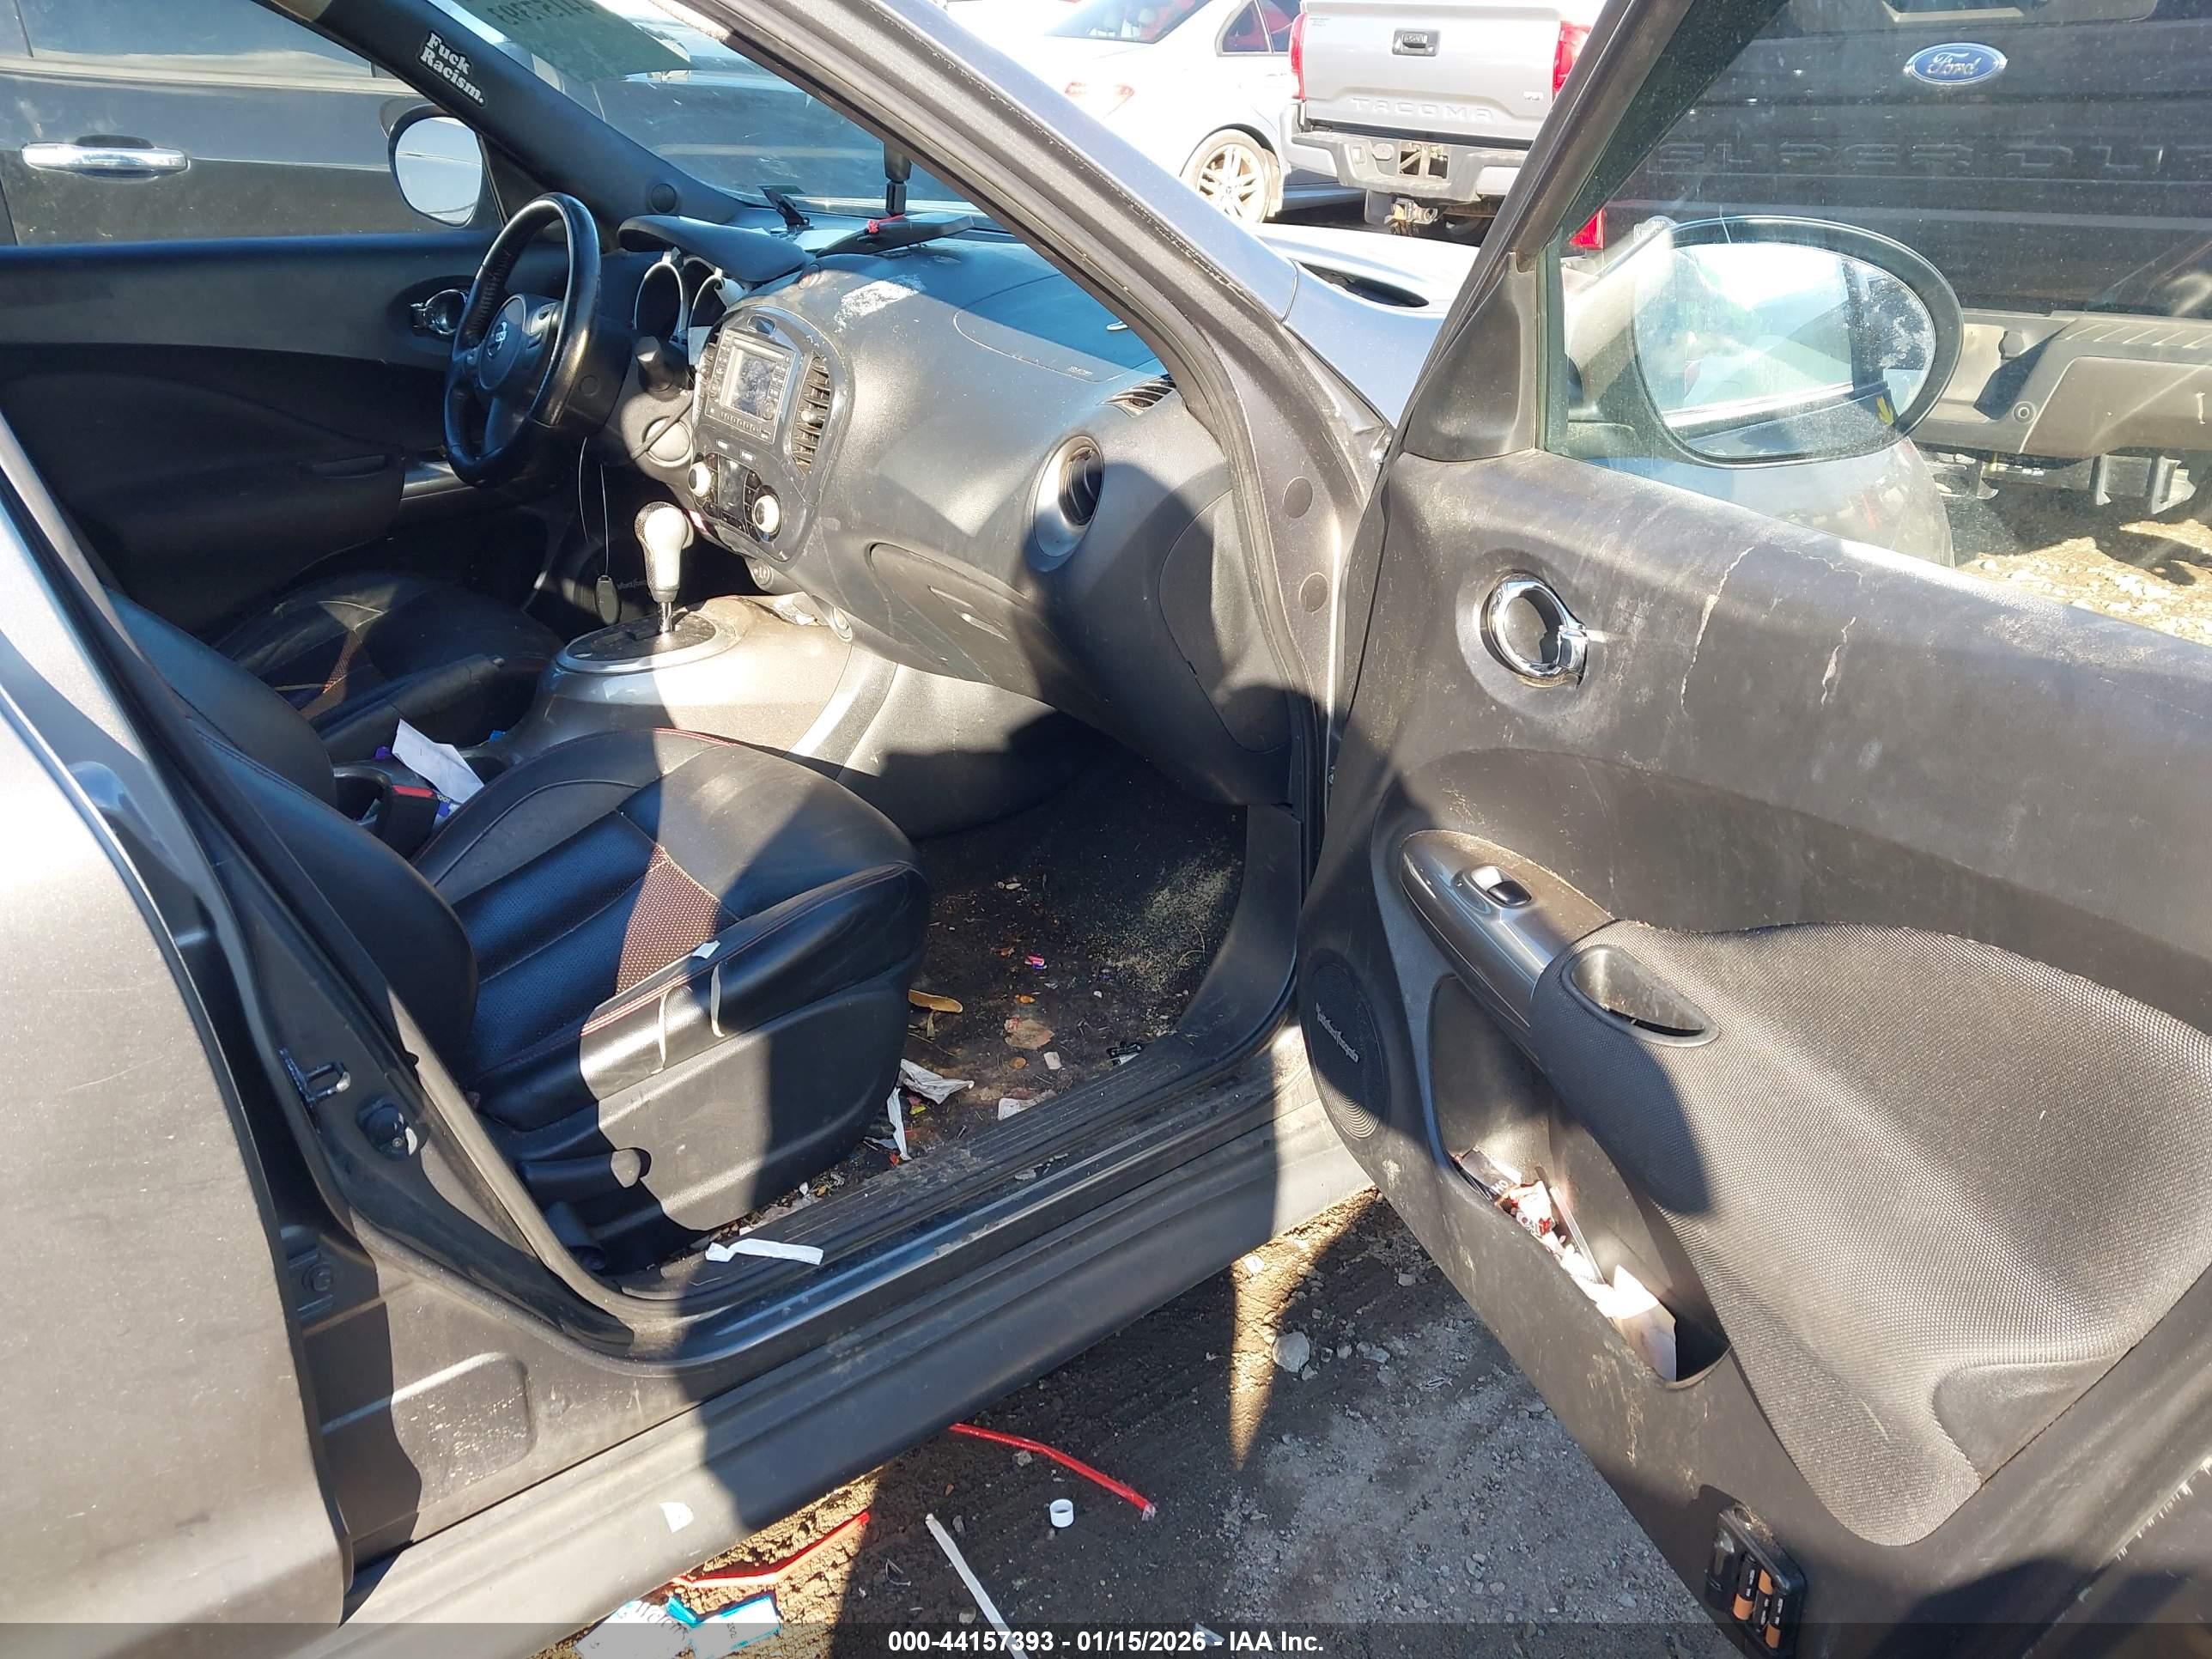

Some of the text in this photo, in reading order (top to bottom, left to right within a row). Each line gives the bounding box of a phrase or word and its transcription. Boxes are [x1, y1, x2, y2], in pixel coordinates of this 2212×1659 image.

[426, 33, 471, 76] Fuck
[1926, 52, 1982, 76] Ford
[420, 46, 484, 104] Racism.
[1352, 97, 1494, 123] TACOMA
[1656, 142, 1974, 171] SUPER
